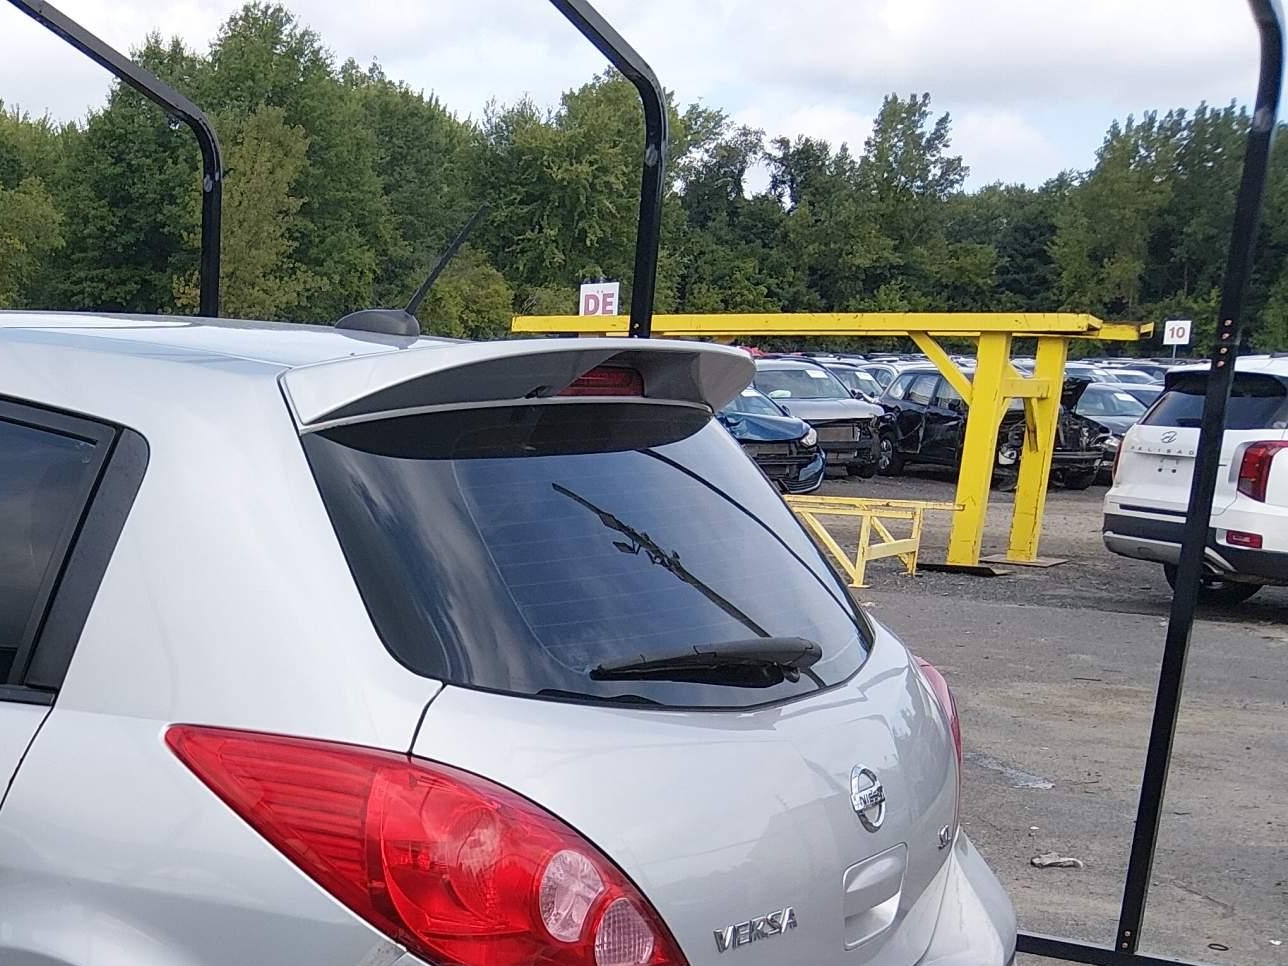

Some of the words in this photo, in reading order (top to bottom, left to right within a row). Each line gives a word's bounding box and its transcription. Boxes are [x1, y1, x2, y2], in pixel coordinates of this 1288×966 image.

[583, 292, 615, 316] DE
[1168, 326, 1186, 339] 10
[1129, 444, 1196, 456] PALISAD
[713, 905, 798, 954] VERSA
